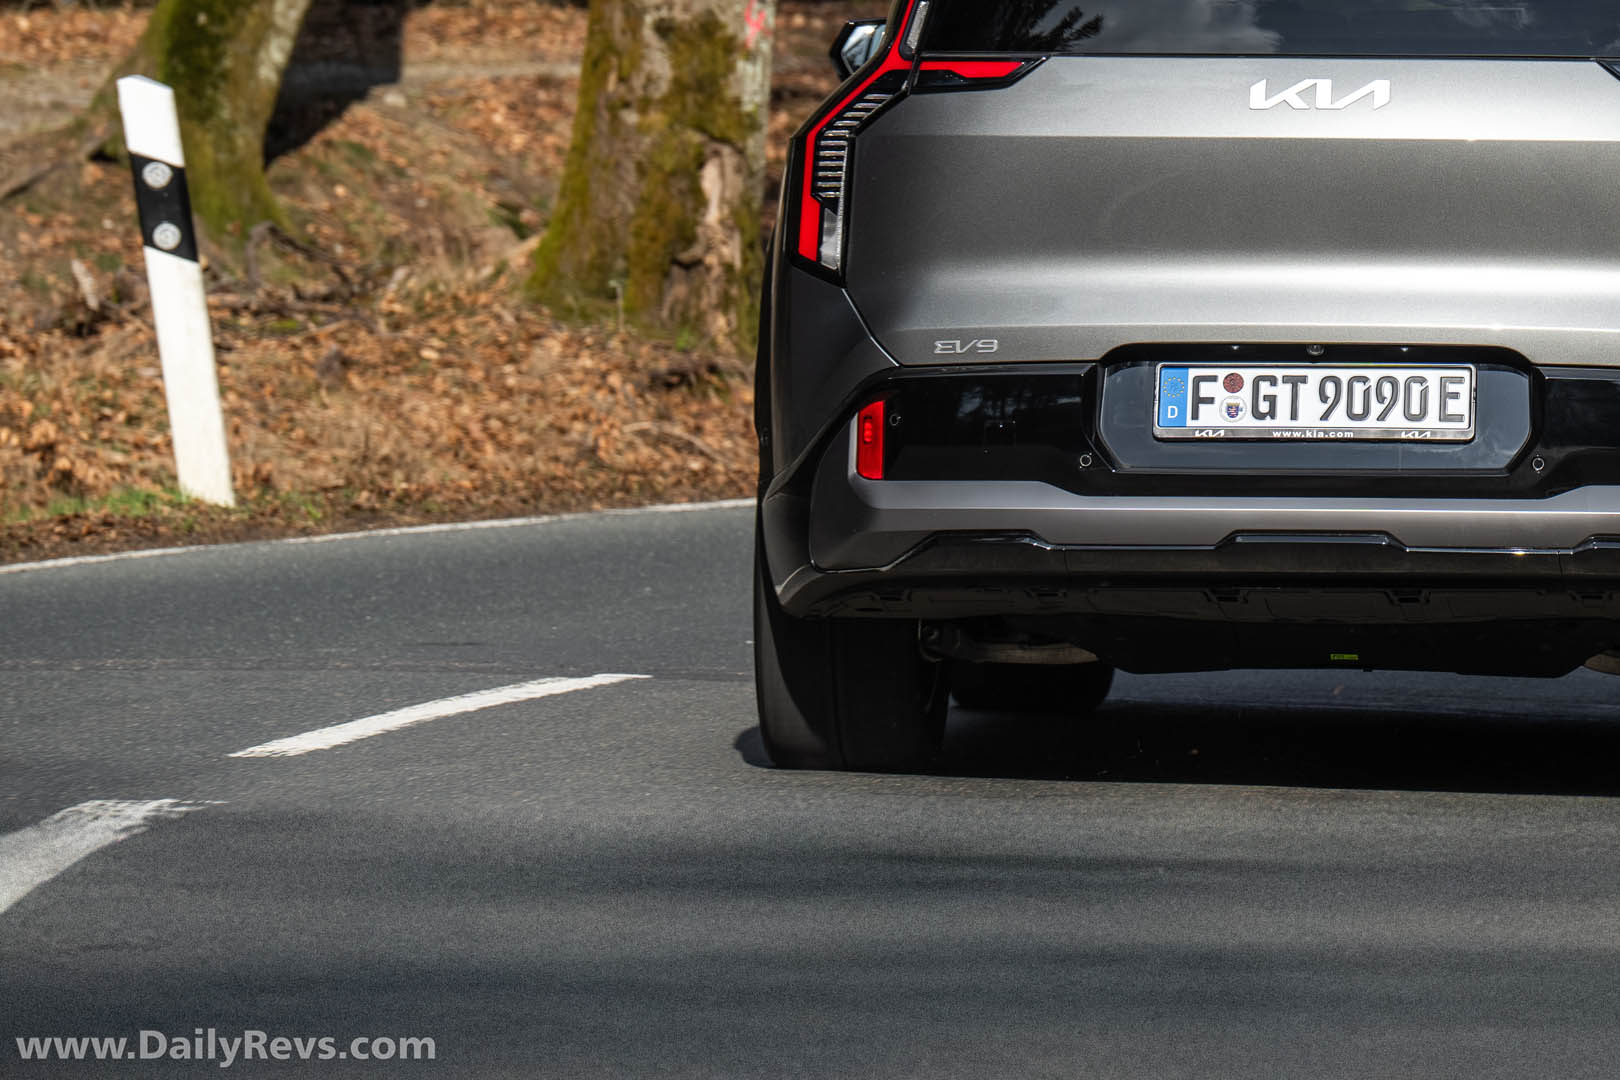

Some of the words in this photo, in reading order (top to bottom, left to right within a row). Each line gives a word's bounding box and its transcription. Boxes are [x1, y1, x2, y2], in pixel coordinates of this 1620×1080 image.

[1249, 78, 1391, 110] KIA
[934, 339, 998, 353] EV9
[1191, 375, 1219, 421] F
[1251, 375, 1308, 422] GT
[1167, 405, 1178, 419] D
[1272, 430, 1354, 438] www.kia.com
